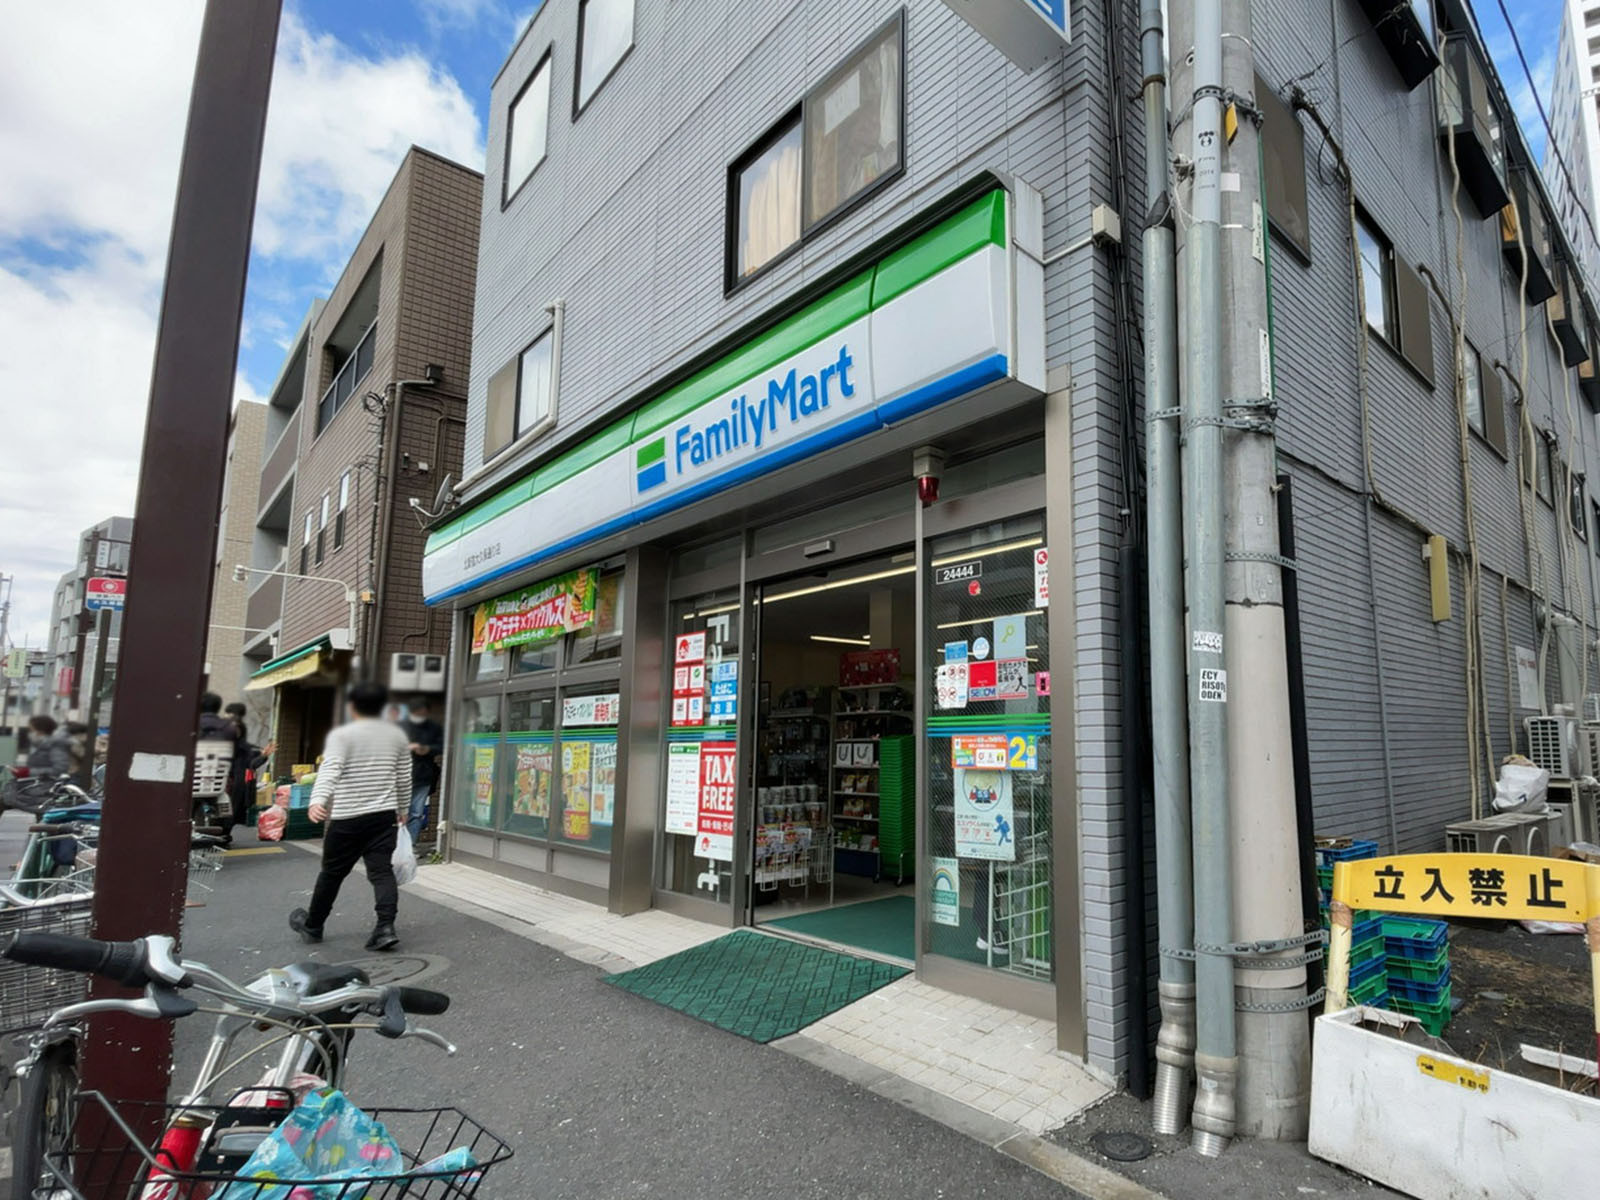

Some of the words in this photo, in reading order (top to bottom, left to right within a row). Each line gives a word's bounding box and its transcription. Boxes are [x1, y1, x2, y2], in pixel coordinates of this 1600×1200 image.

[675, 344, 854, 474] FamilyMart
[943, 565, 974, 581] 24444
[1009, 736, 1027, 768] 2
[704, 754, 736, 784] TAX
[702, 785, 734, 811] FREE
[1373, 865, 1567, 909] 立入禁止
